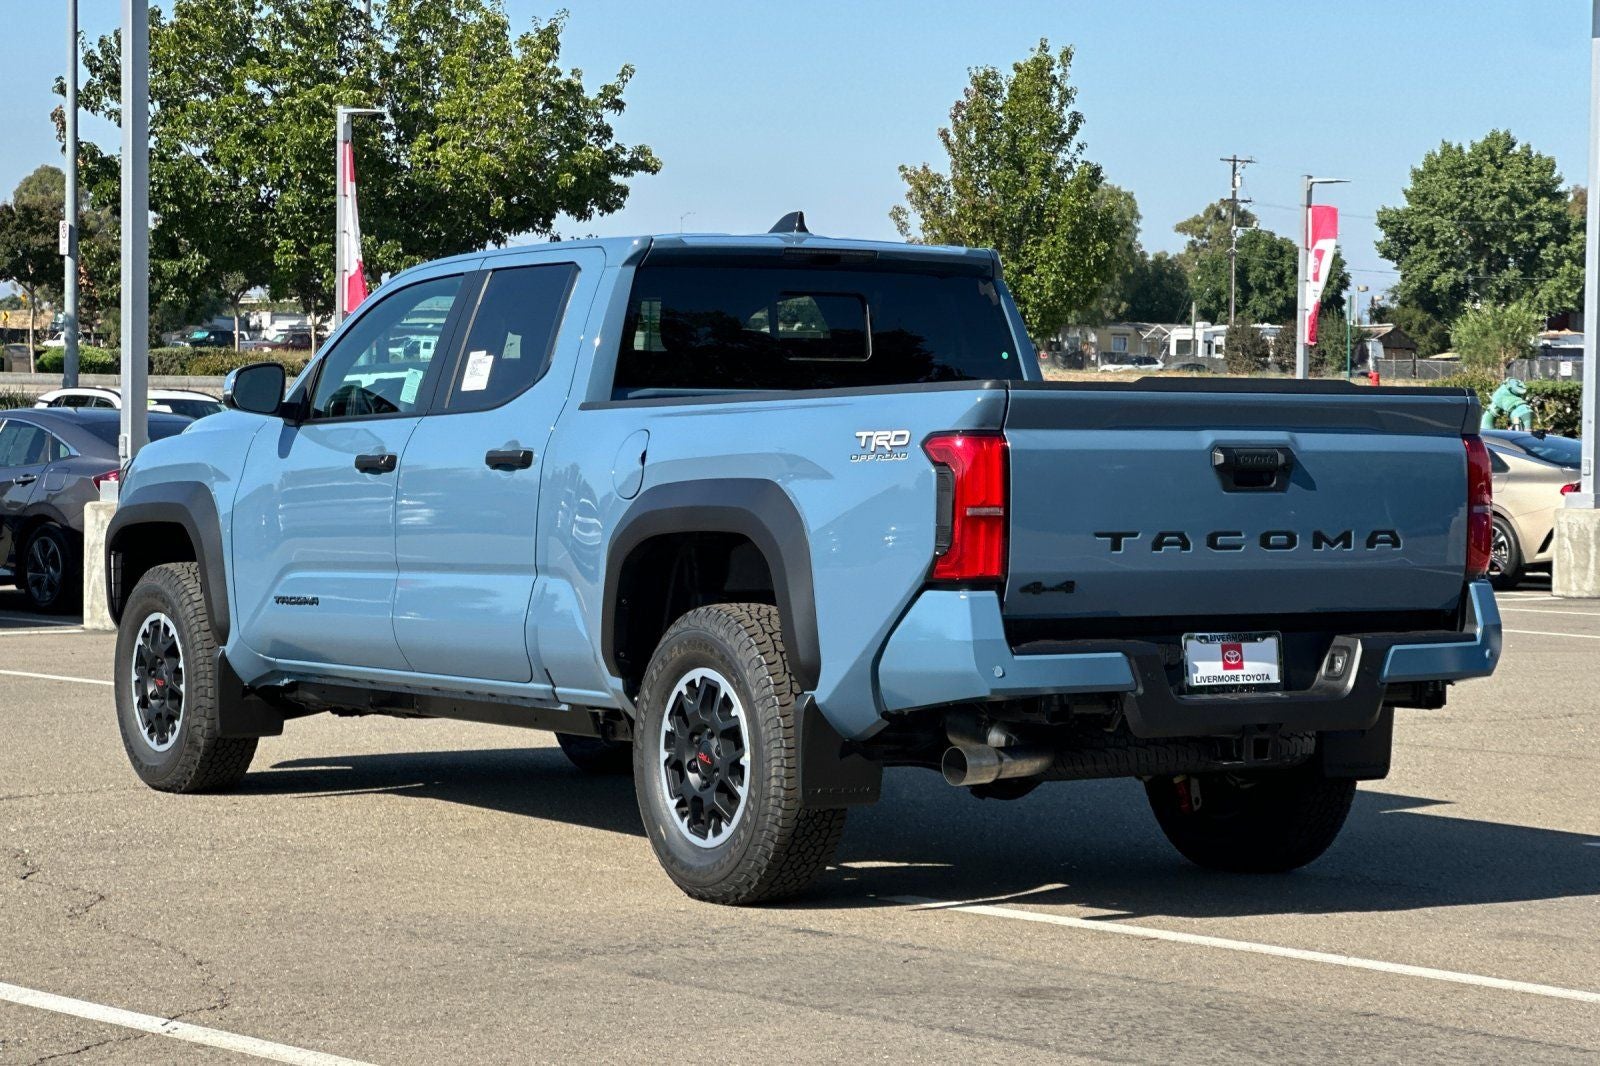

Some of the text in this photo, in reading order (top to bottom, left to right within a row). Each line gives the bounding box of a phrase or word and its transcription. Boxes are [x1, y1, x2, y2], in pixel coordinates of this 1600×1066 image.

[855, 430, 911, 452] TRD
[1094, 530, 1403, 553] TACOMA
[273, 595, 320, 606] TACOMA
[1195, 673, 1271, 684] LIVERMORE TOYOTA
